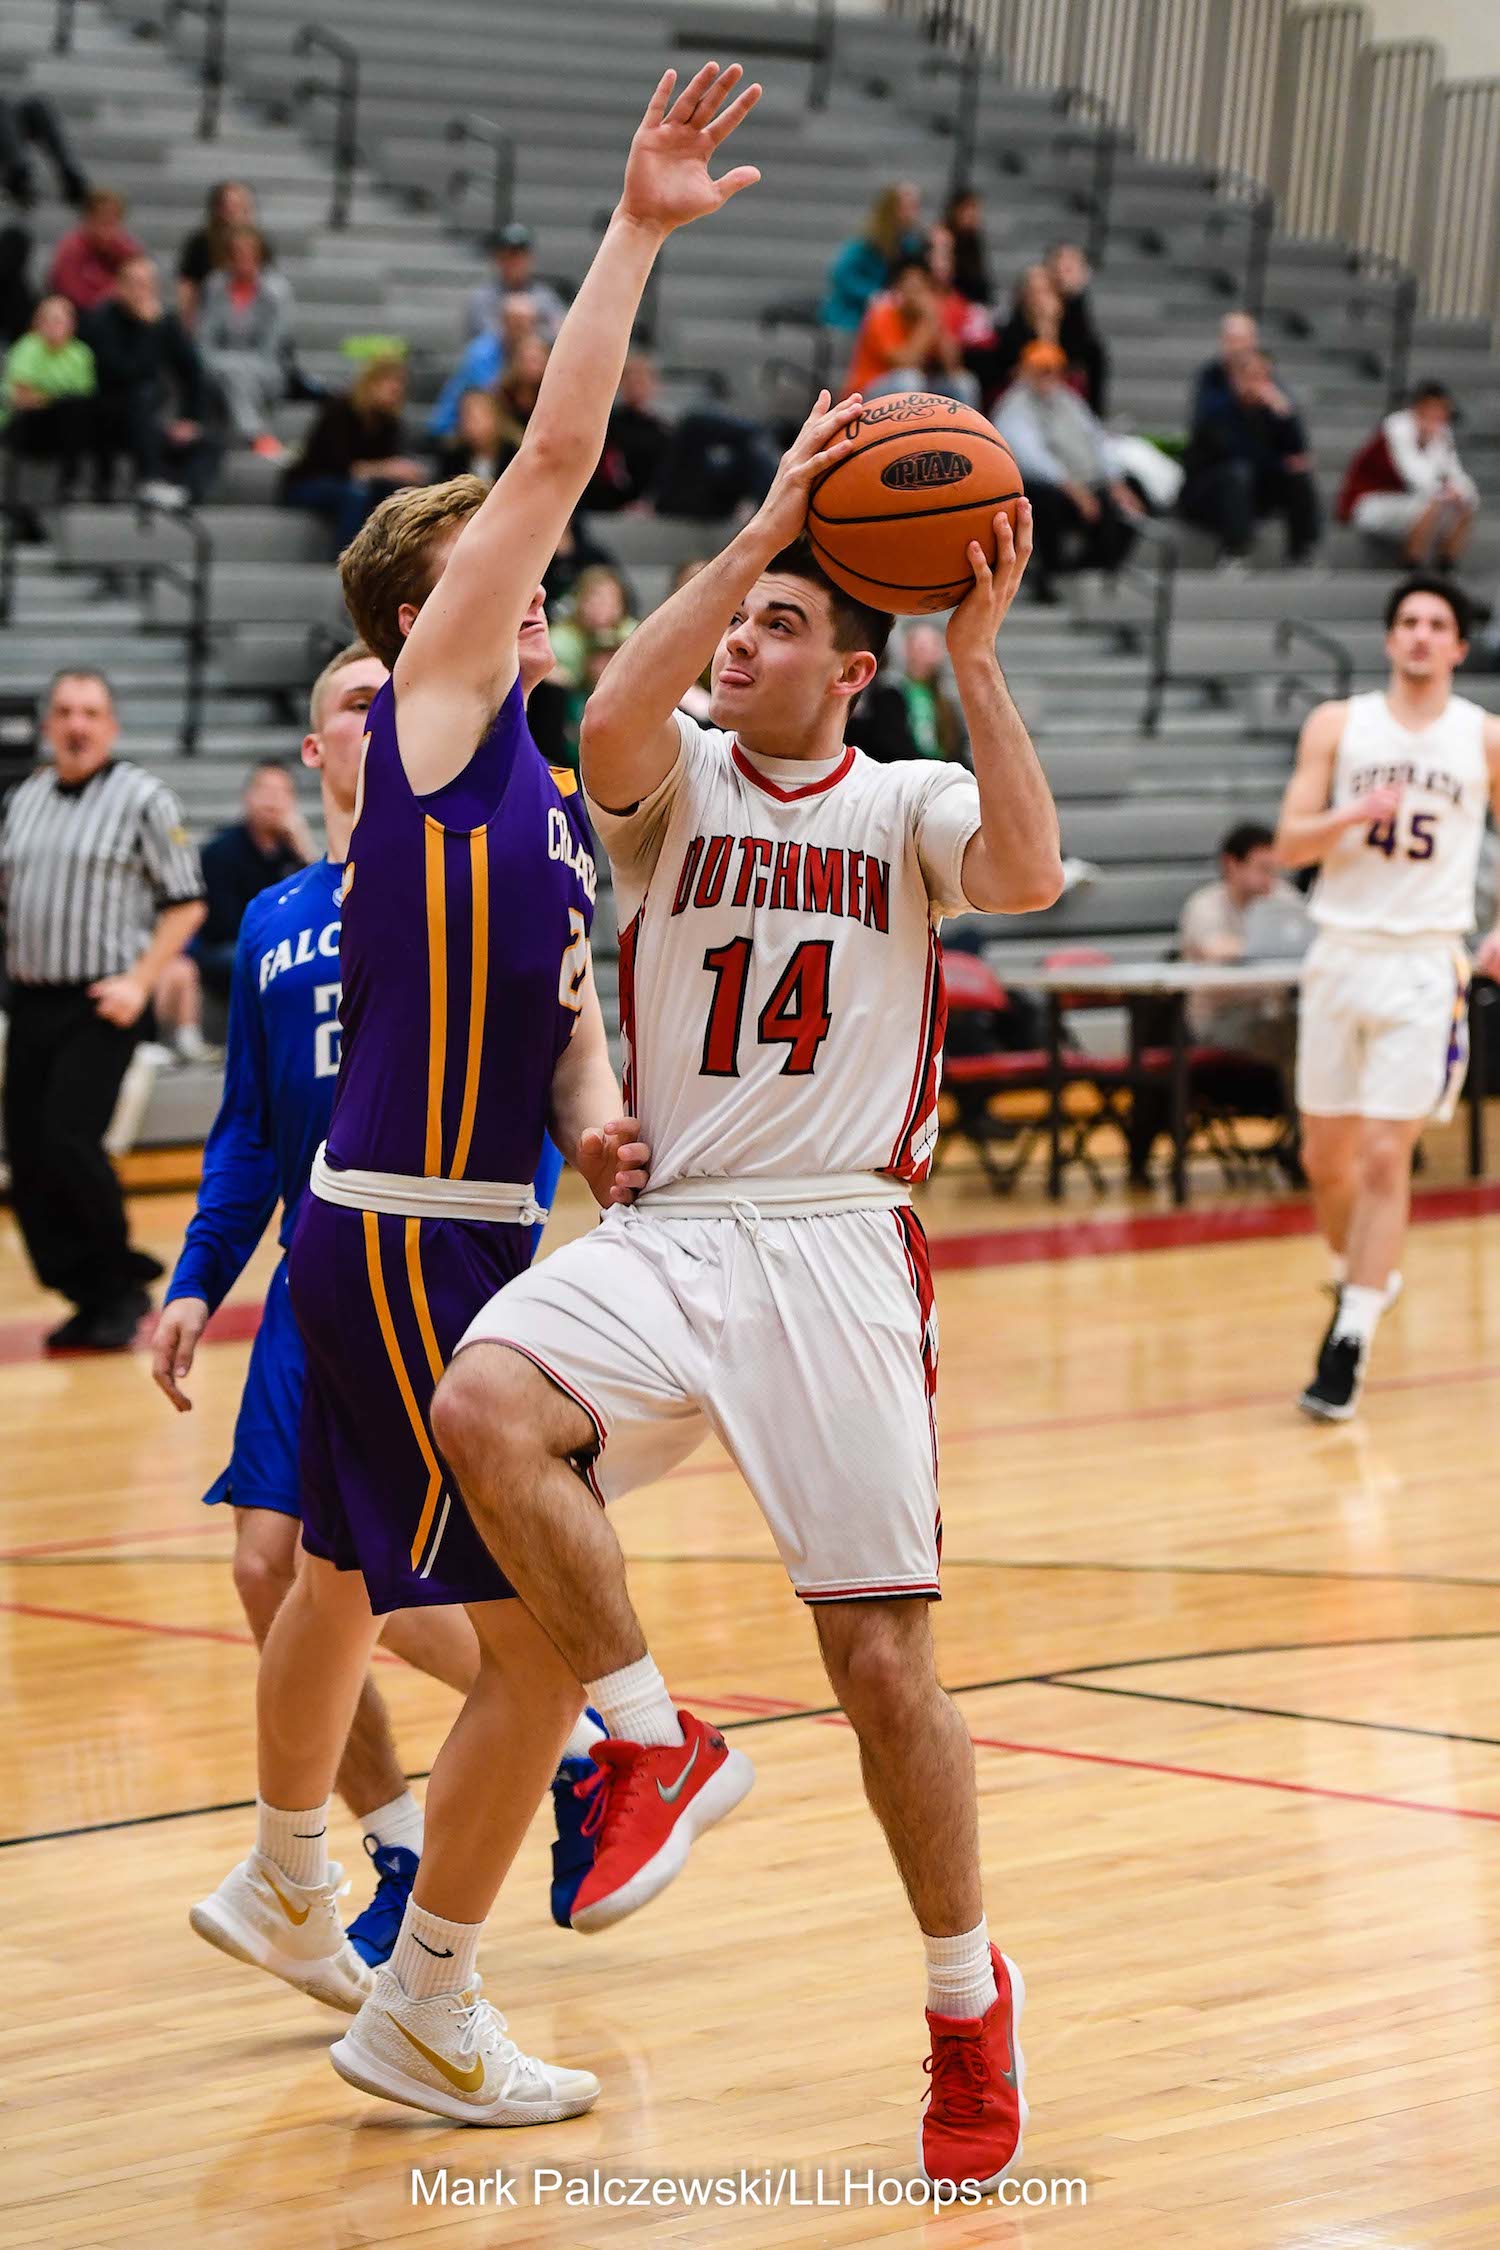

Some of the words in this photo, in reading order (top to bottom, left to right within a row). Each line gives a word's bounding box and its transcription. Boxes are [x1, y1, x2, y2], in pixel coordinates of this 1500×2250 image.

[895, 453, 968, 486] PIAA
[1366, 815, 1438, 860] 45
[698, 935, 834, 1077] 14
